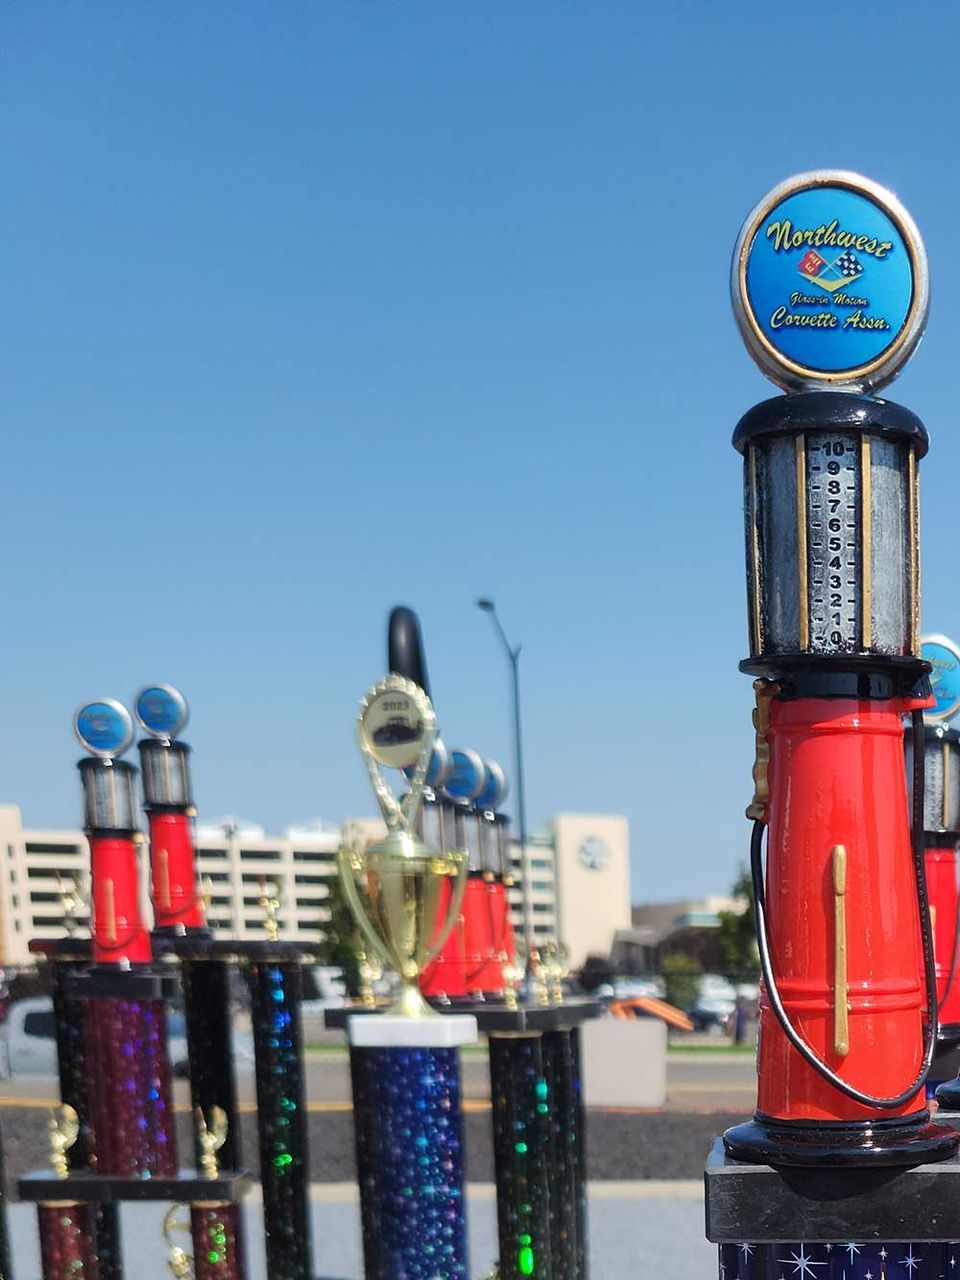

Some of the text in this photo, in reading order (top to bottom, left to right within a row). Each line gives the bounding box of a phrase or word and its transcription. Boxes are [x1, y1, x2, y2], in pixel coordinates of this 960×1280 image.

[766, 220, 892, 257] Northwest
[833, 293, 868, 305] Motion
[770, 306, 890, 329] Corvette Assn.
[822, 441, 845, 456] 10
[827, 461, 840, 475] 9
[827, 481, 841, 494] 8
[828, 499, 841, 513] 7
[828, 518, 841, 532] 6
[829, 538, 841, 551] 5
[829, 556, 842, 570] 4
[829, 575, 842, 589] 3
[830, 594, 842, 607] 2
[831, 613, 842, 626] 1
[830, 631, 842, 645] 0
